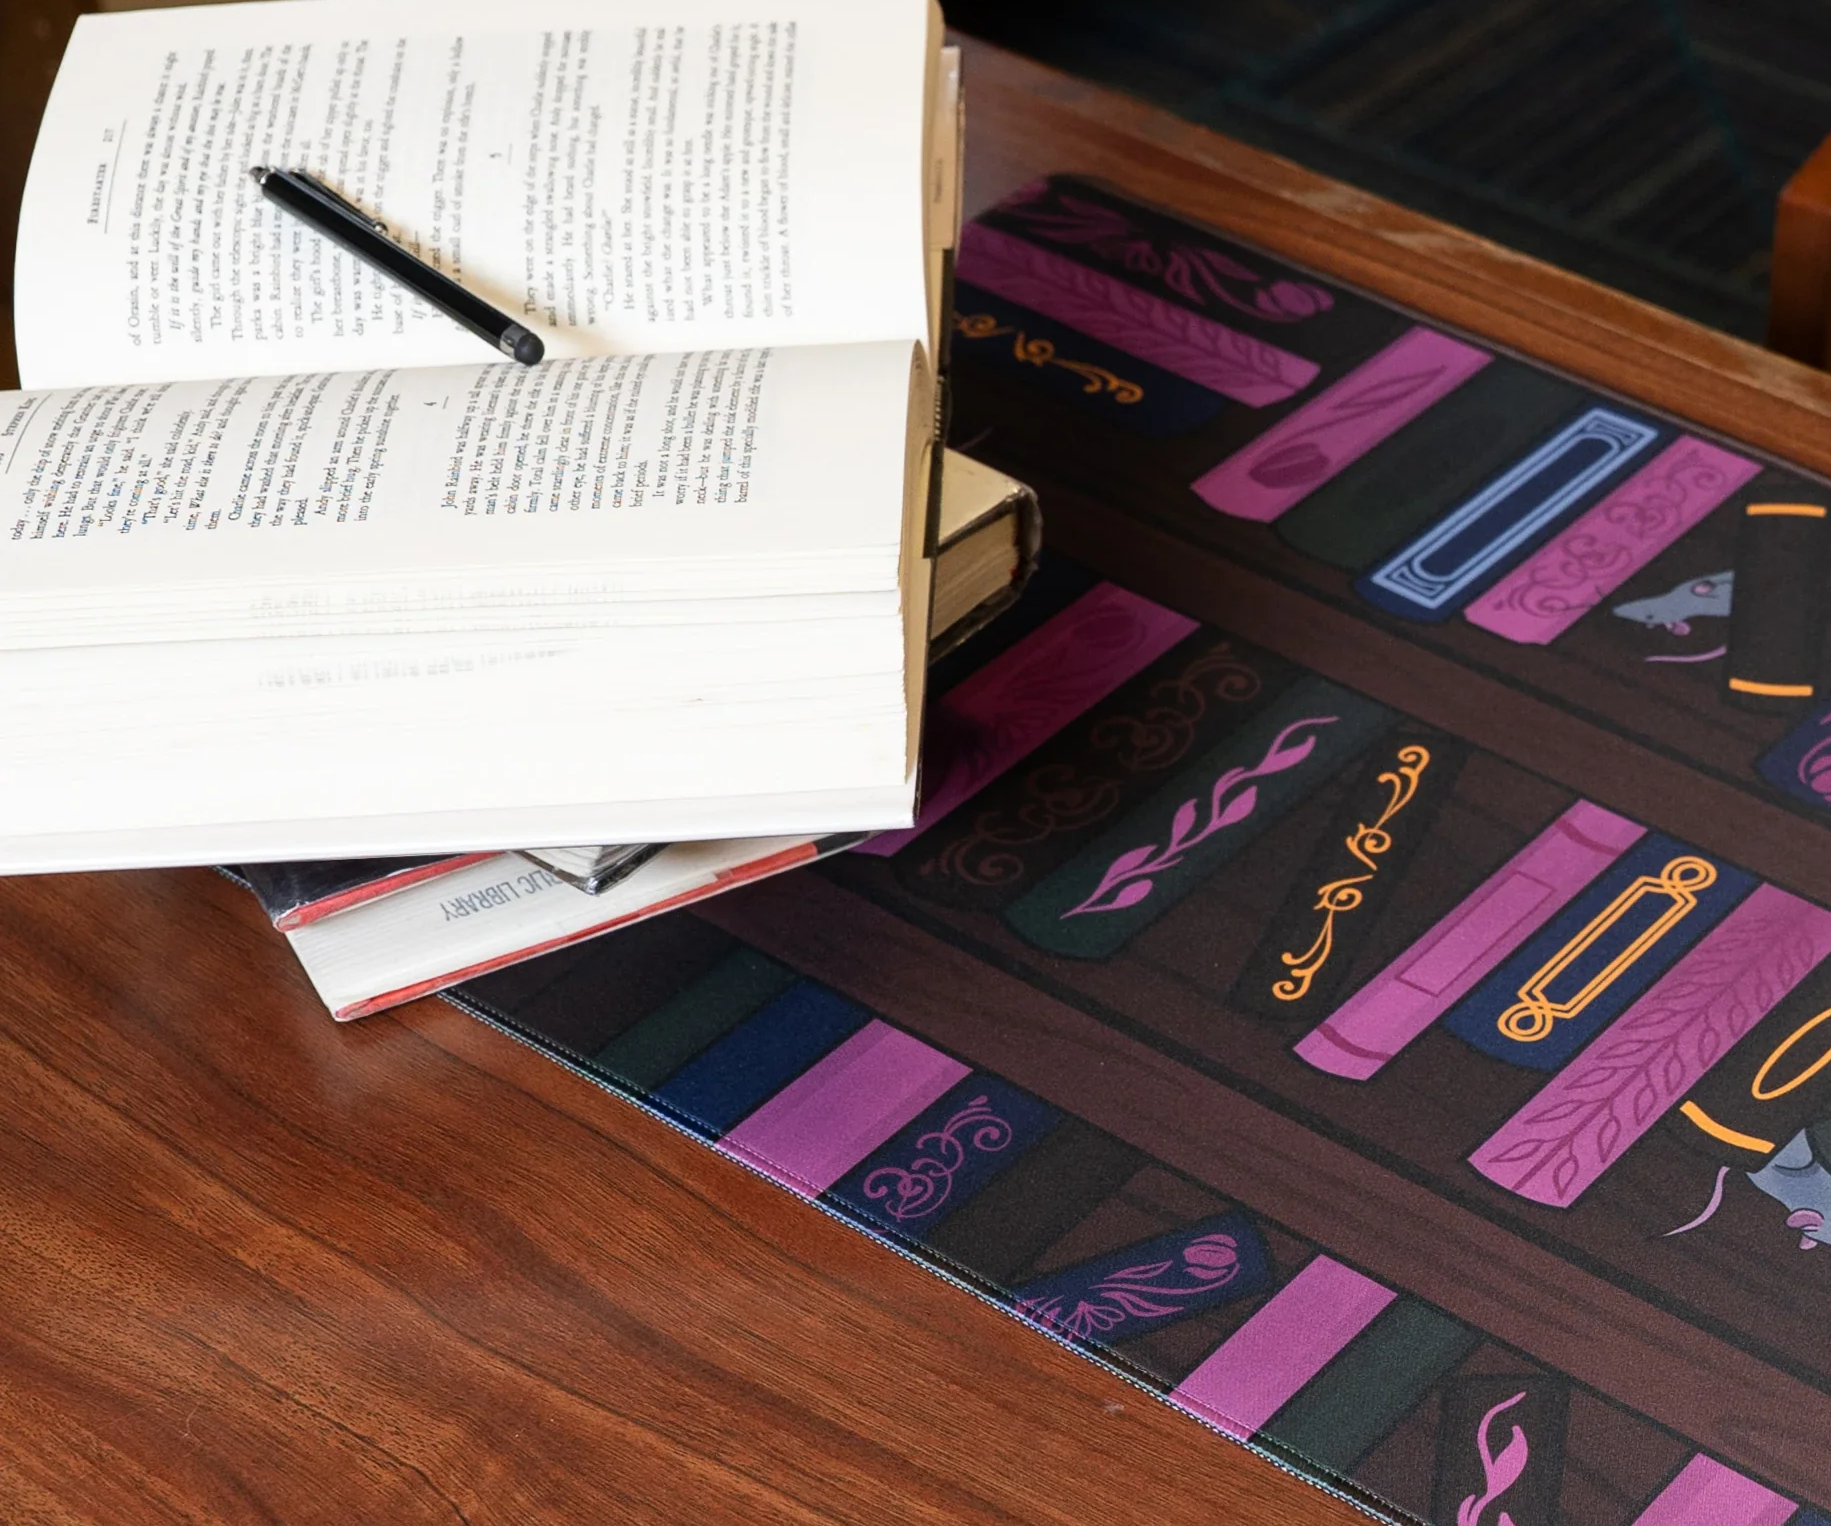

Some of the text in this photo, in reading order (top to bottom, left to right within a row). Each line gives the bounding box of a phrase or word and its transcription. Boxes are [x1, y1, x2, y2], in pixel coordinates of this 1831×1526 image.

[657, 435, 676, 452] long
[702, 438, 712, 451] was
[345, 446, 362, 465] Then
[676, 453, 690, 467] had
[697, 453, 711, 463] he
[738, 454, 751, 469] this
[95, 456, 111, 478] would
[114, 465, 129, 474] he
[440, 440, 466, 508] John Rainbird was
[488, 458, 504, 475] held
[573, 462, 586, 473] he
[658, 460, 668, 473] not
[716, 465, 729, 481] that
[737, 470, 750, 479] of
[27, 474, 42, 487] the
[70, 481, 82, 489] to
[173, 475, 188, 488] the
[319, 467, 338, 493] slipped
[486, 476, 500, 491] belt
[507, 473, 521, 492] door
[528, 466, 543, 487] Total
[611, 470, 625, 488] back
[656, 474, 666, 488] was
[22, 488, 40, 505] only
[87, 480, 103, 495] that
[128, 479, 149, 507] coming
[169, 489, 184, 500] hit
[269, 464, 295, 527] the way they had
[337, 484, 353, 502] brief
[463, 460, 483, 516] yards away. He
[591, 465, 606, 510] moments of
[675, 483, 690, 505] worry
[713, 482, 732, 503] thing
[734, 481, 748, 503] barrel
[62, 490, 78, 505] had
[80, 497, 97, 511] But
[188, 489, 204, 509] What
[227, 473, 252, 521] Charlie came
[251, 495, 267, 510] had
[313, 495, 333, 516] Andy
[353, 472, 380, 522] into the early
[503, 493, 518, 514] cabin
[548, 492, 560, 513] came
[568, 490, 581, 511] other
[612, 488, 623, 508] came
[629, 489, 644, 507] brief
[29, 511, 50, 540] himself
[43, 479, 65, 508] wishing
[57, 506, 73, 518] He
[336, 503, 349, 523] more
[185, 511, 201, 531] time,
[247, 512, 266, 528] they
[11, 519, 30, 540] today
[439, 881, 520, 921] LIBRARY
